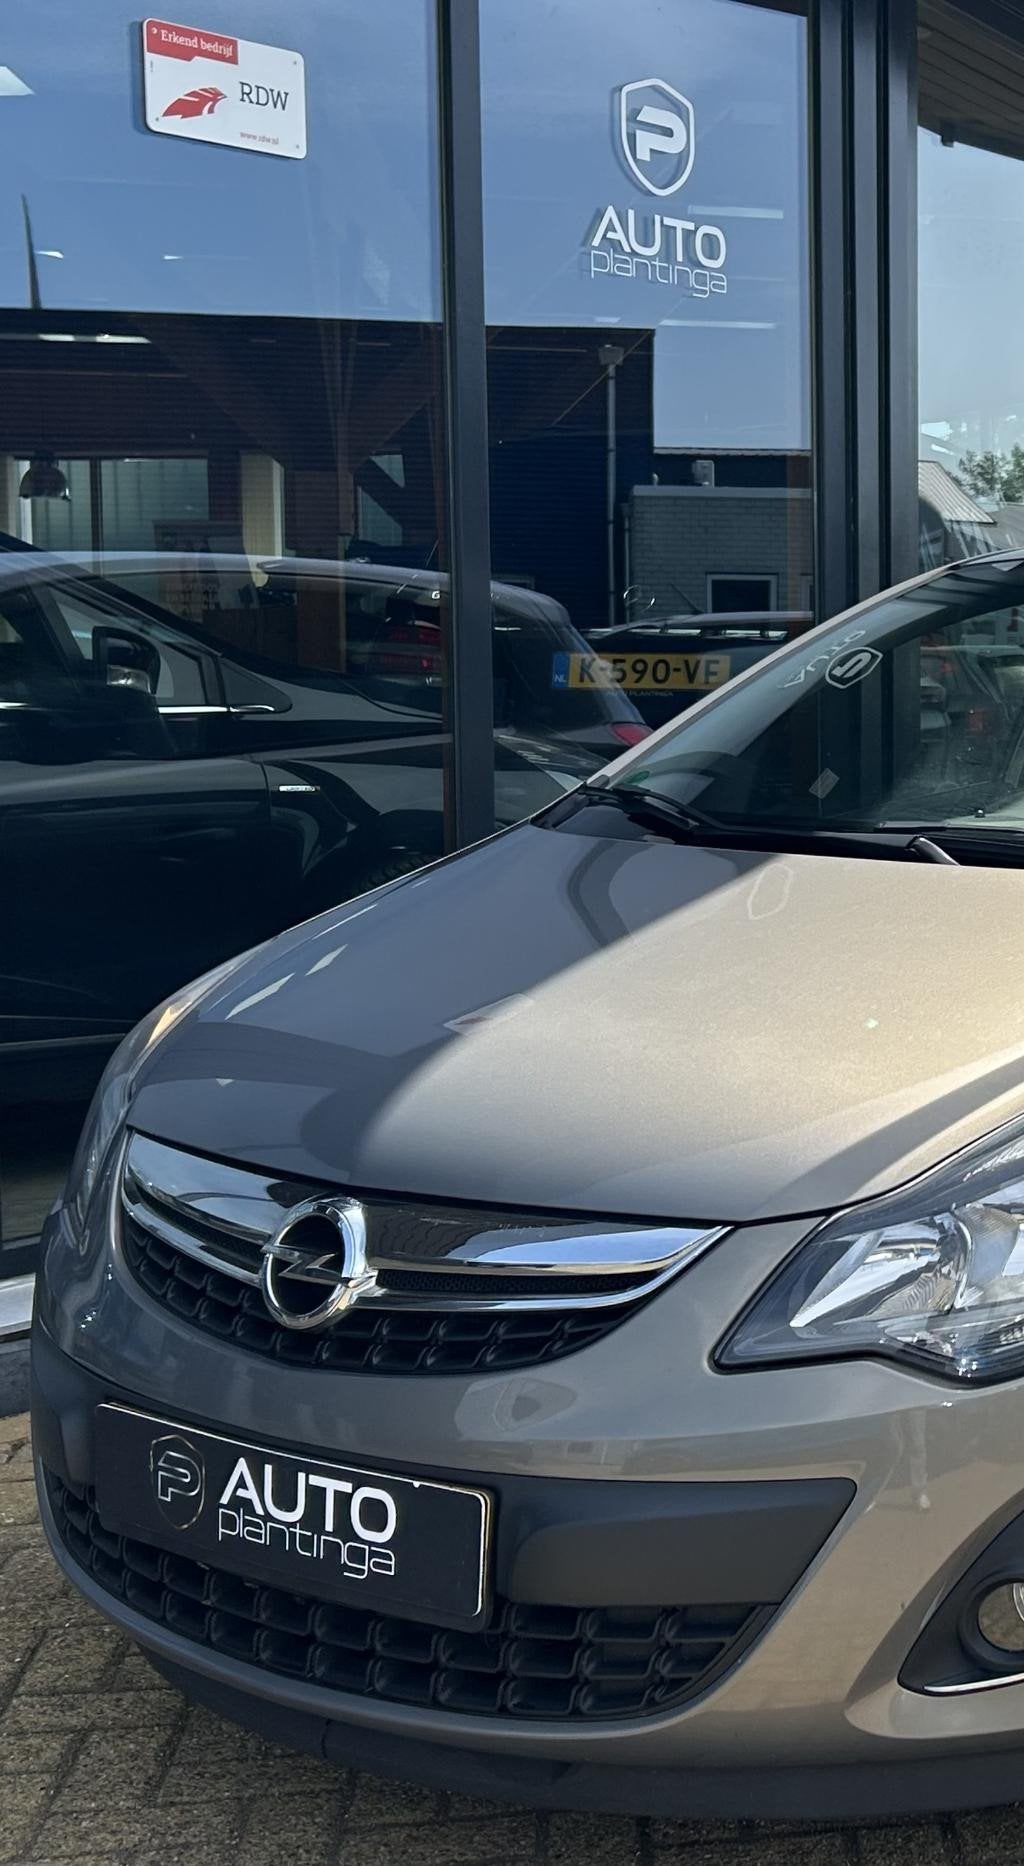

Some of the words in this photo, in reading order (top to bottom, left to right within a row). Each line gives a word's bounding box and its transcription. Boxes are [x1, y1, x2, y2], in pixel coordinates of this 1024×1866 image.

[160, 28, 199, 49] Erkend
[200, 38, 234, 58] bedrijf
[239, 81, 290, 112] RDW
[591, 205, 727, 269] AUTO
[590, 248, 728, 298] plantinga
[578, 657, 720, 685] K-590-VF
[219, 1457, 397, 1543] AUTO
[218, 1507, 396, 1580] plantinga
